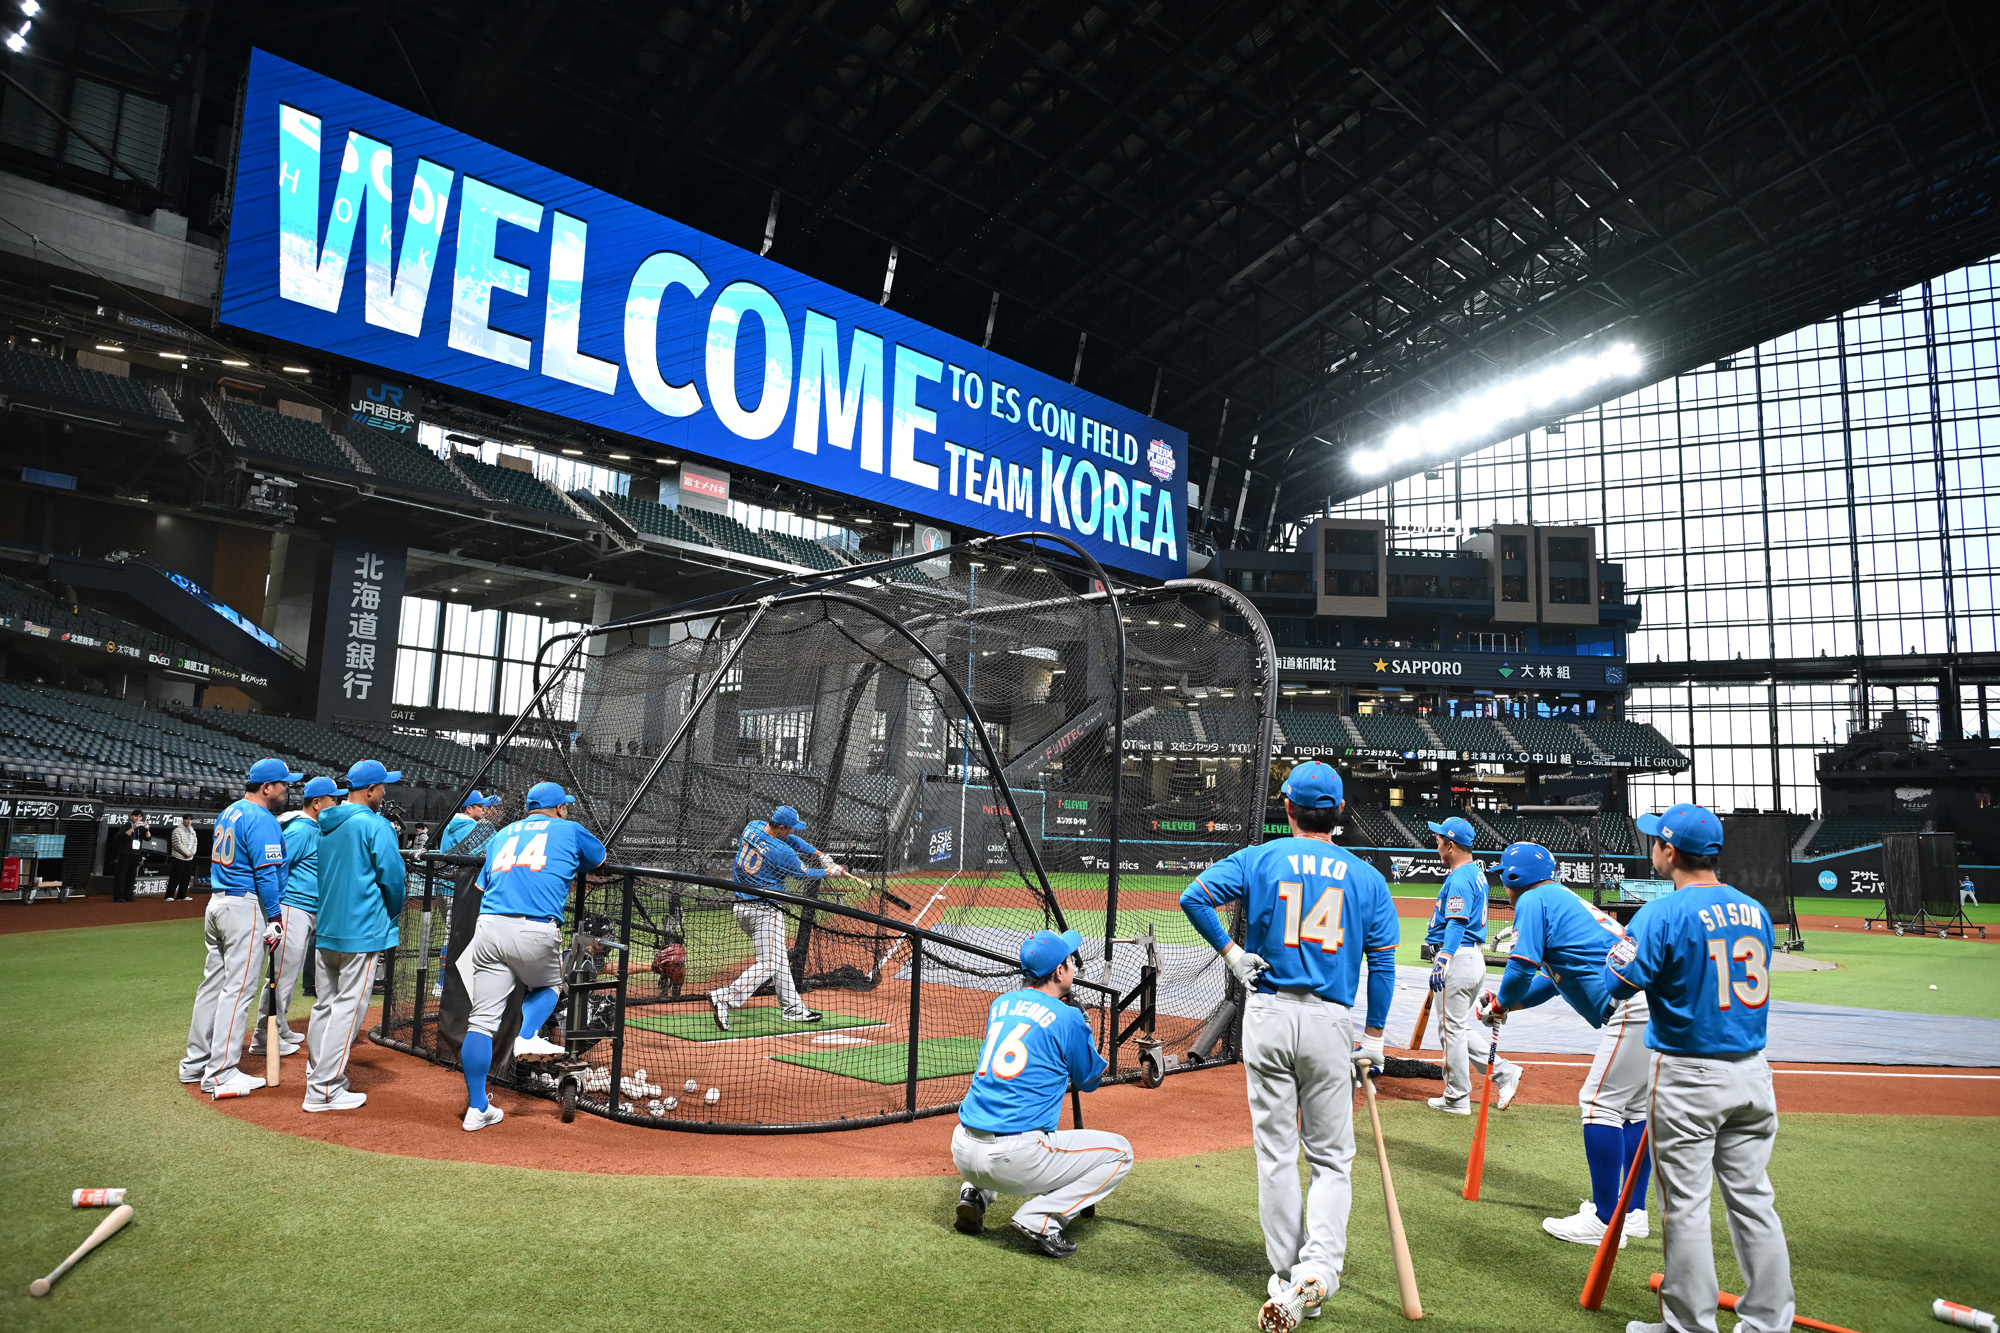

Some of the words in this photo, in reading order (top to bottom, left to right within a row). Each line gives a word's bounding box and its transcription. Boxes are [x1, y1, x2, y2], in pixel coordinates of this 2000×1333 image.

[279, 101, 944, 492] WELCOME
[366, 384, 404, 407] JR
[351, 400, 415, 423] JR西日本
[949, 364, 984, 409] TO
[991, 380, 1021, 423] ES
[1027, 396, 1076, 444] CON
[1082, 416, 1139, 466] FIELD
[684, 476, 726, 494] 富士メガネ
[944, 440, 1033, 519] TEAM
[1040, 446, 1178, 562] KOREA
[341, 551, 385, 700] 北海道銀行
[1392, 659, 1463, 676] SAPPORO
[1519, 664, 1571, 679] 大林組
[390, 709, 416, 721] GATE
[1045, 724, 1084, 760] FUJITEC
[1294, 745, 1334, 756] nepia
[1471, 752, 1514, 762] 北海道バス
[1532, 754, 1572, 765] 中山組
[1591, 754, 1616, 762] CSP
[1653, 757, 1689, 768] GROUP
[15, 805, 47, 816] トドック
[72, 803, 95, 814] ほくでん
[1058, 798, 1089, 810] 7-ELEVEN
[514, 821, 522, 832] S
[524, 820, 551, 832] CHO
[1151, 820, 1197, 831] 7-ELEVEN
[211, 824, 236, 867] 20
[930, 829, 953, 846] ASK
[491, 833, 549, 873] 44
[929, 841, 953, 856] GATE
[737, 839, 764, 876] 10
[1560, 861, 1591, 883] 東進
[1819, 876, 1837, 885] Wolt
[1850, 870, 1879, 881] アサヒ
[1278, 881, 1344, 954] 14
[1726, 902, 1762, 930] SON
[1708, 936, 1769, 1011] 13
[1009, 1000, 1057, 1028] JEONG
[978, 1021, 1032, 1081] 16
